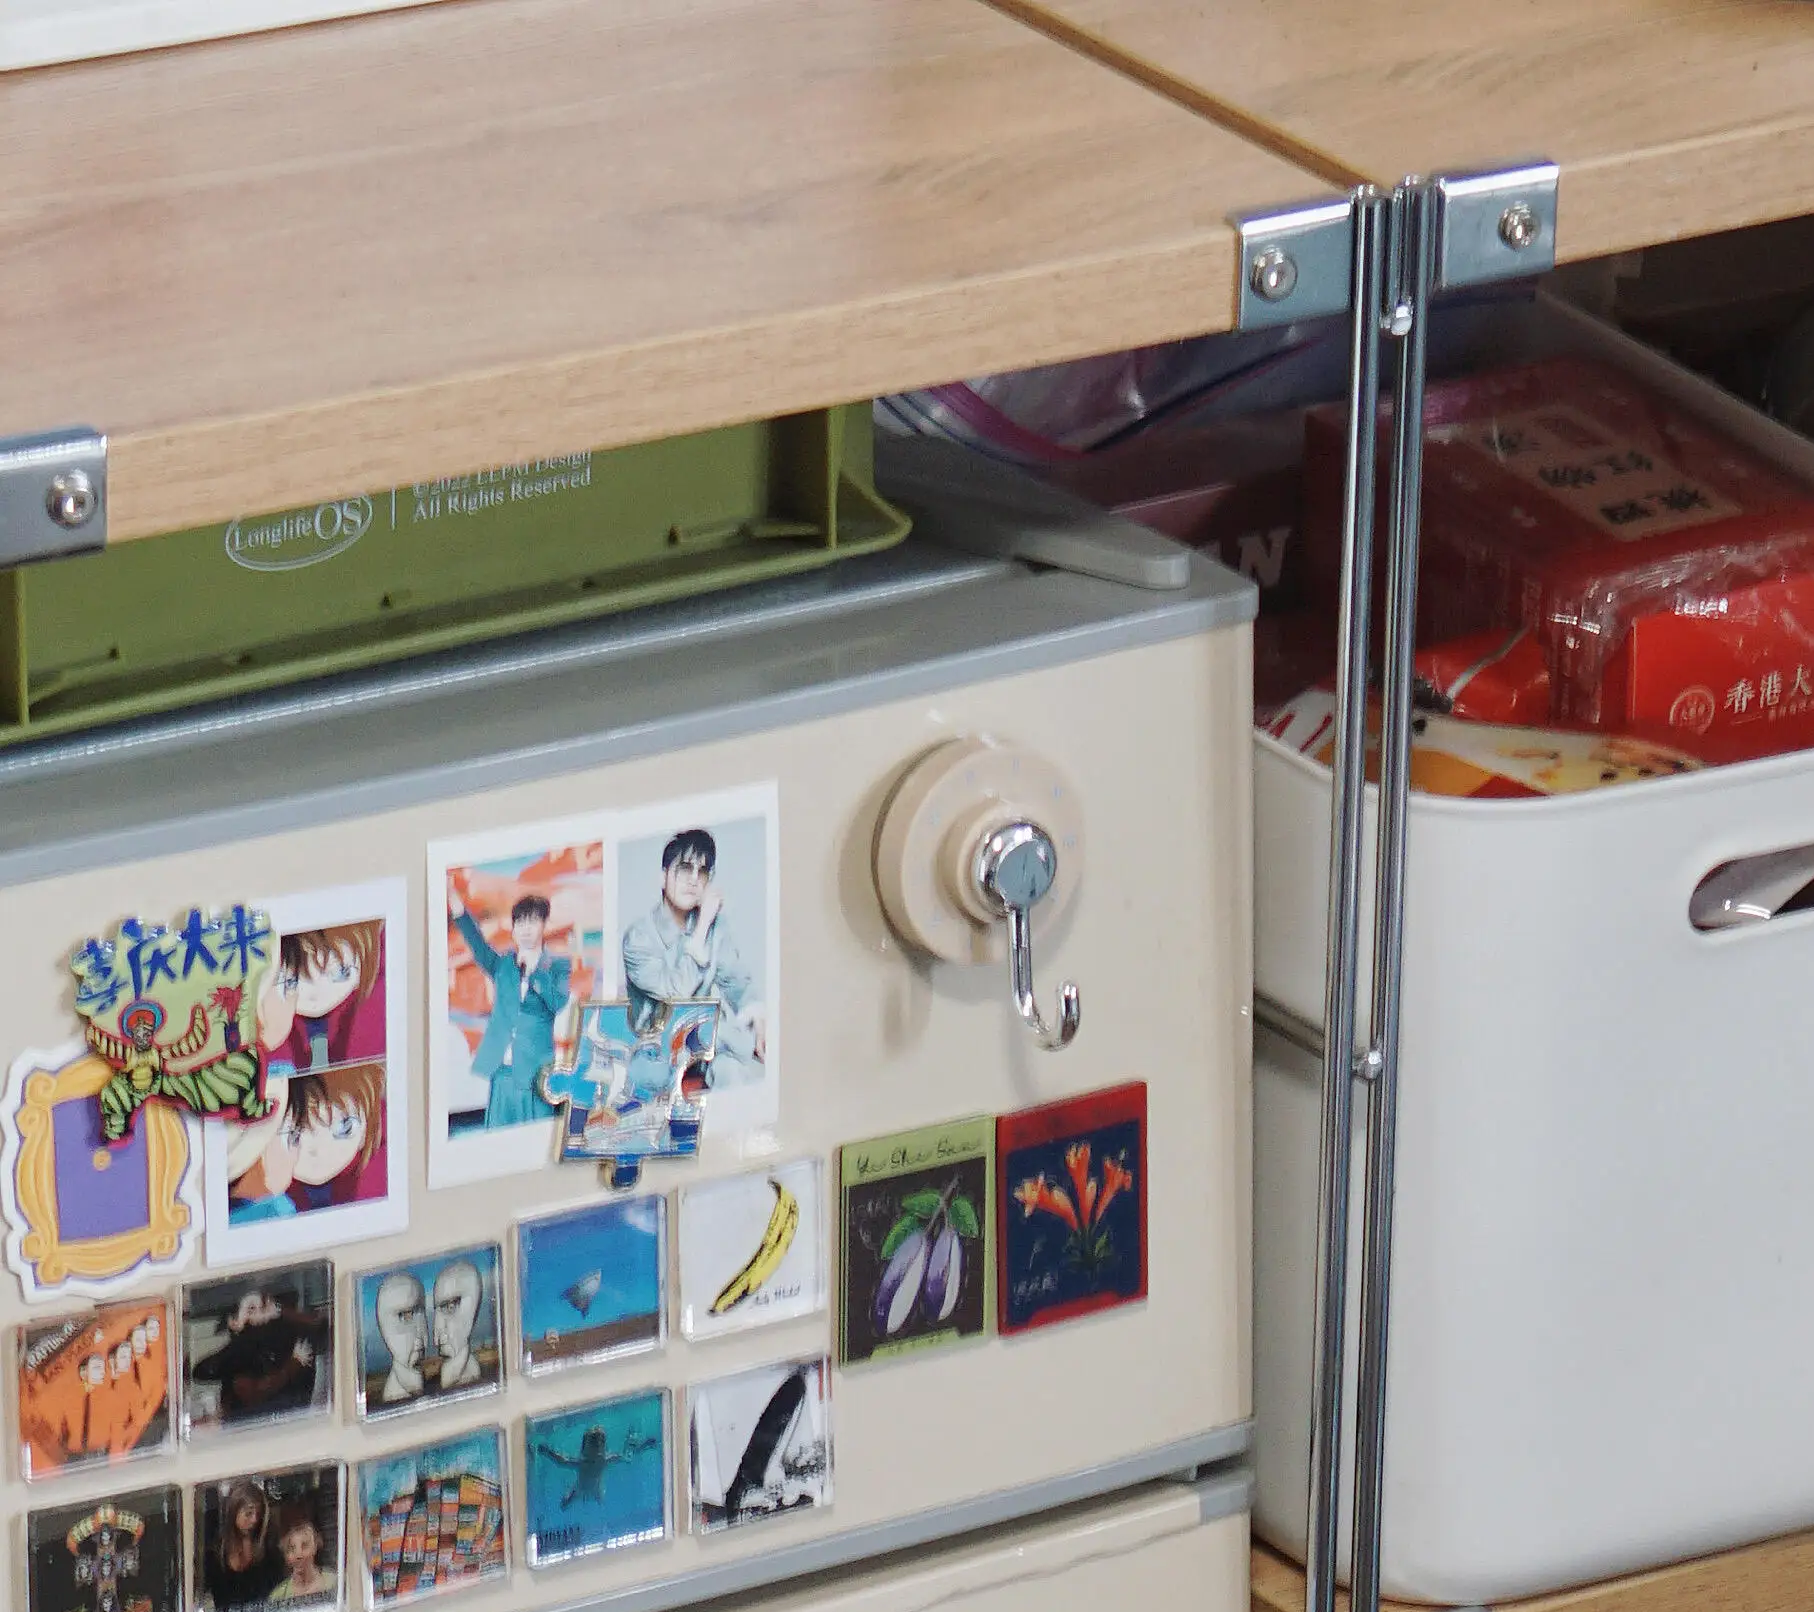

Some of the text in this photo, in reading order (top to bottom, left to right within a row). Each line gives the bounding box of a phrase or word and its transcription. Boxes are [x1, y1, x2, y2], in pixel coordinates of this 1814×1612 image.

[413, 464, 592, 523] All Rights Reserved
